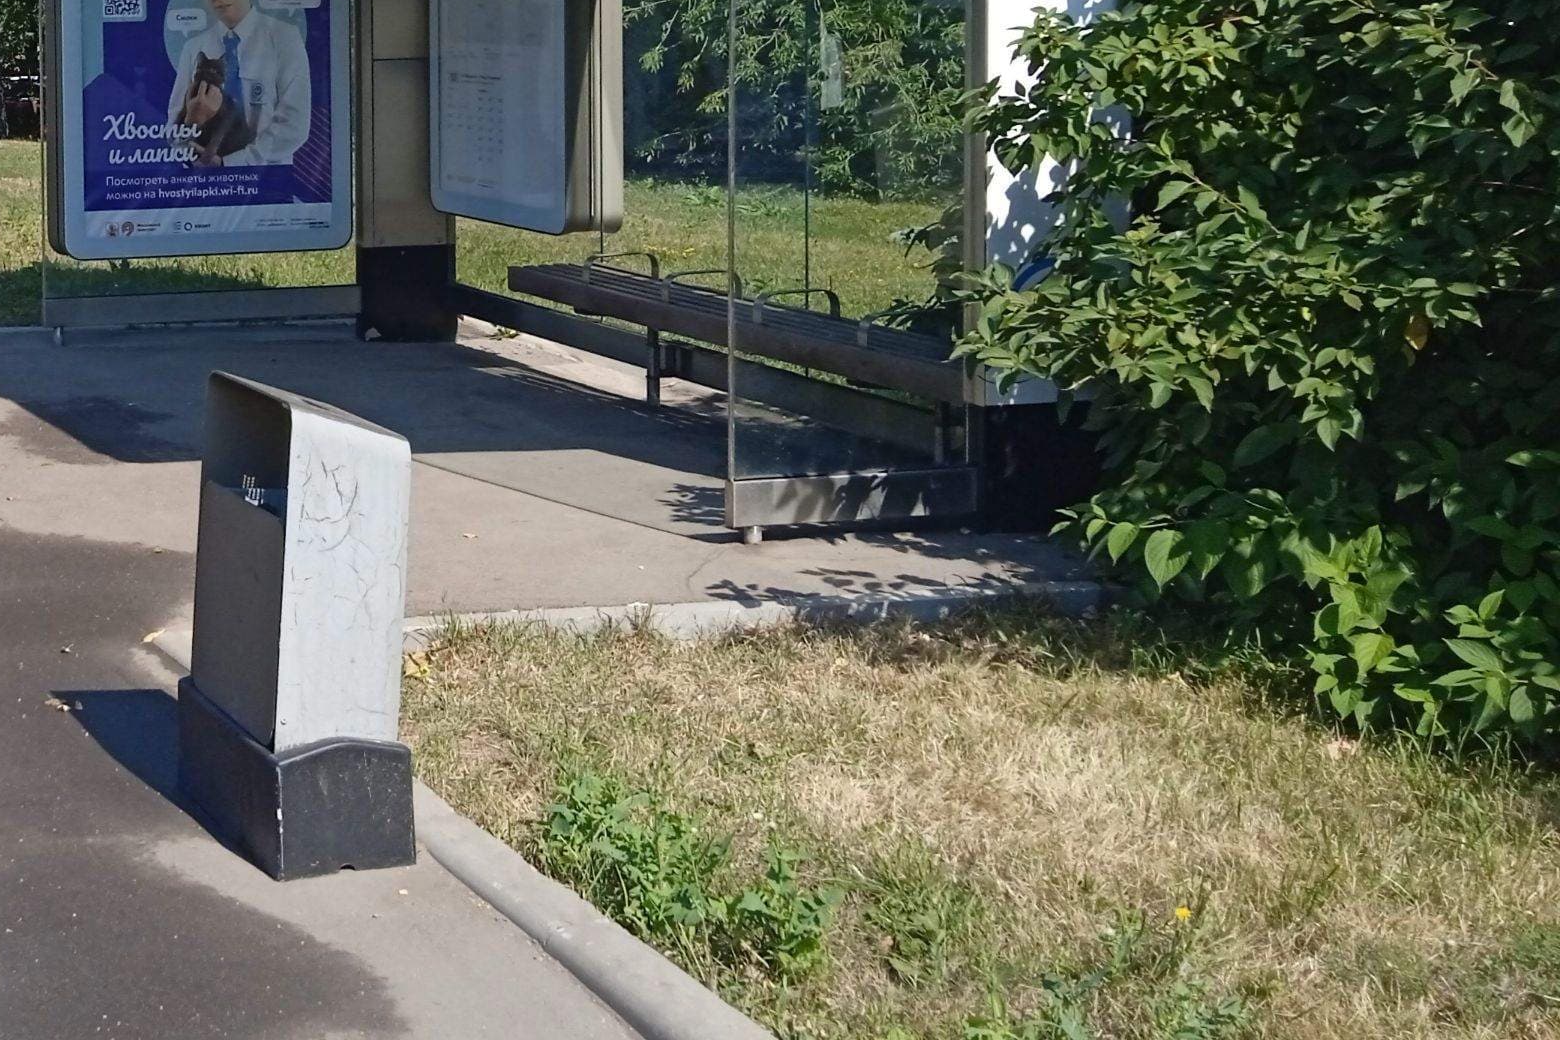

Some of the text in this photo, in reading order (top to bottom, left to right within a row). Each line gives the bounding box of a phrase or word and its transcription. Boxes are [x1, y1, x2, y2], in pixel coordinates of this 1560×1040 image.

[102, 111, 202, 142] Хвосты
[109, 144, 199, 164] и лапки
[106, 172, 260, 188] Посмотреть анкеты животных
[106, 191, 141, 200] можно
[143, 190, 157, 199] на
